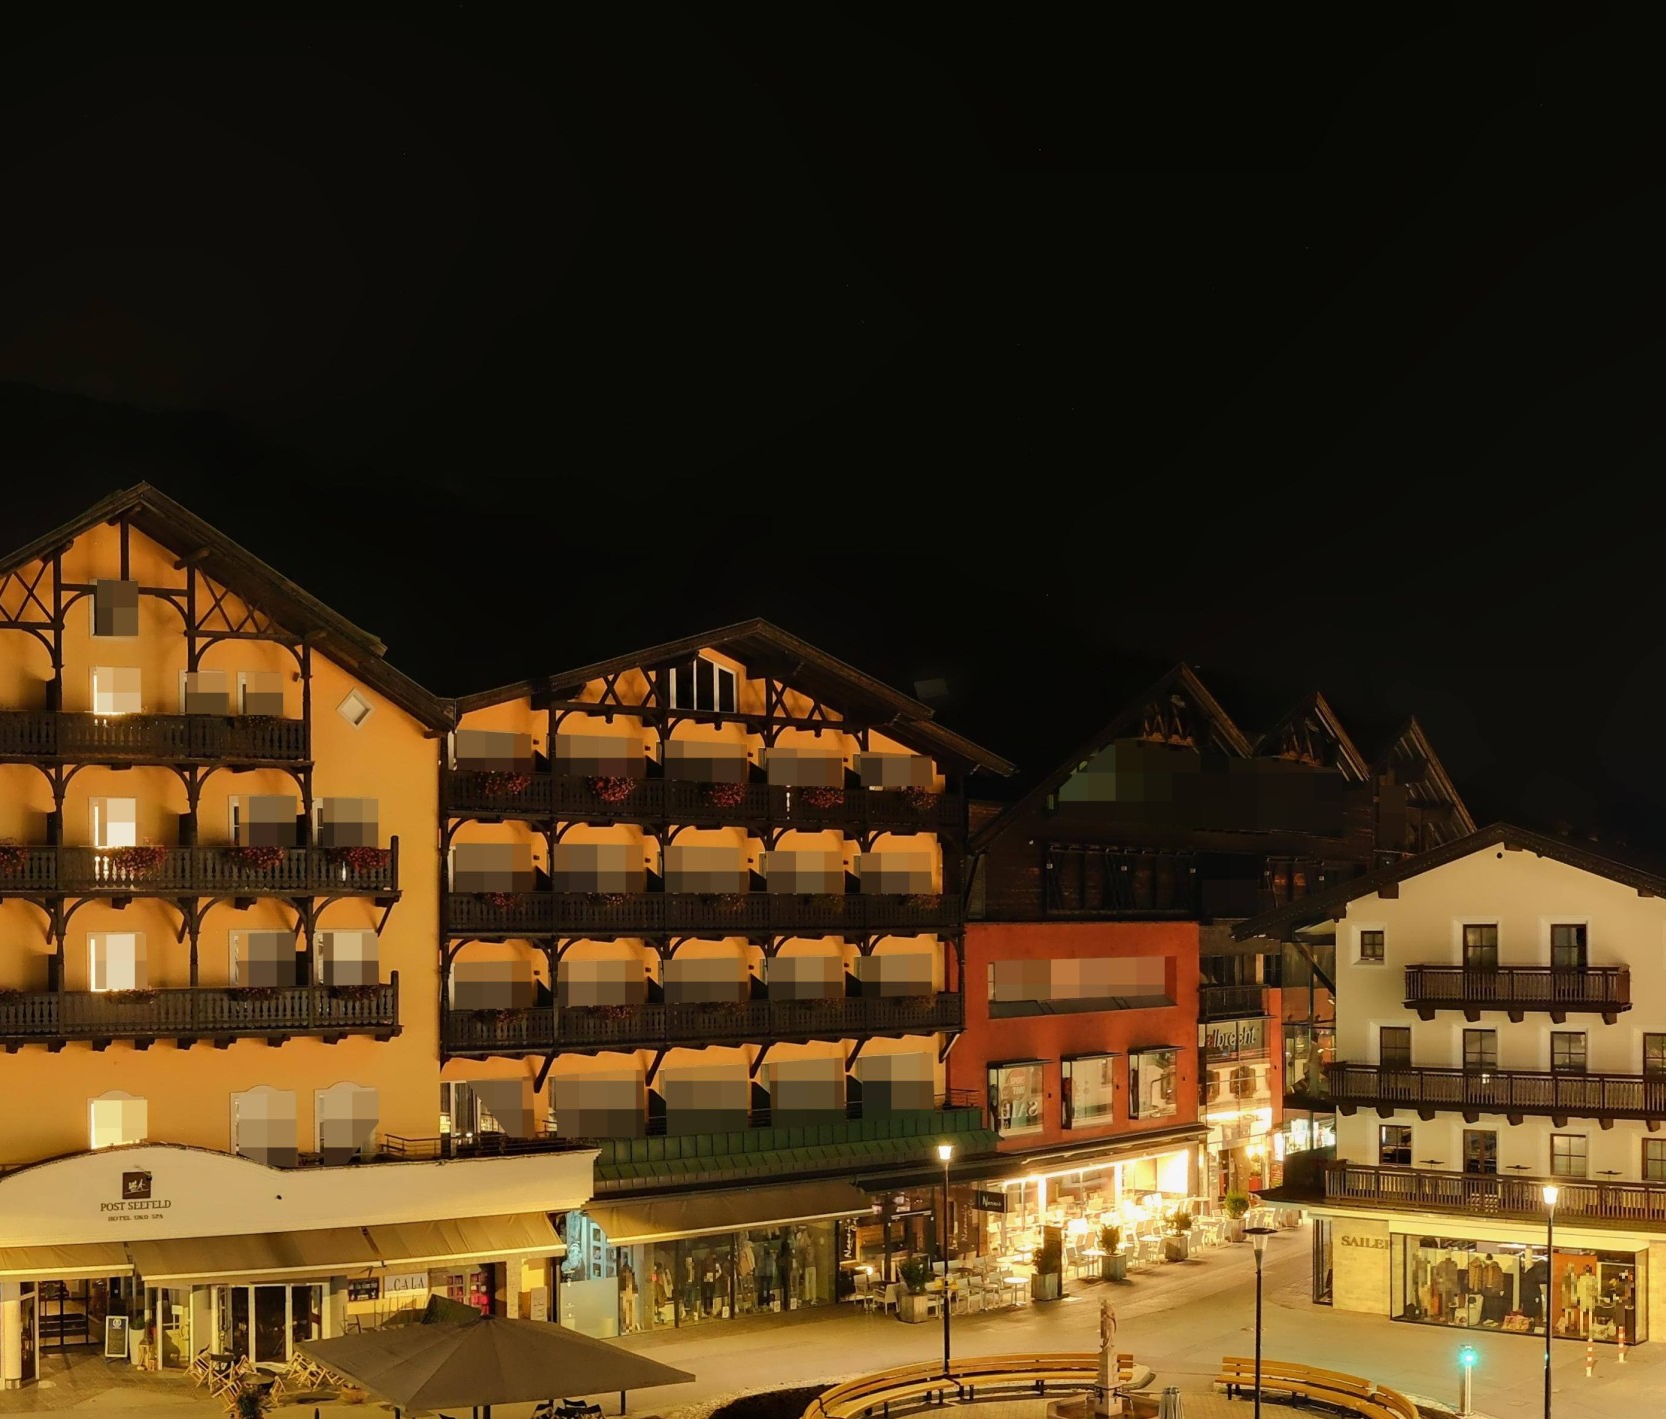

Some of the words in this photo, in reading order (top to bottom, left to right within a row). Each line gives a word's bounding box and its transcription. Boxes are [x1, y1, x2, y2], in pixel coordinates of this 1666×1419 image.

[1206, 1026, 1256, 1050] albrecht
[100, 1202, 126, 1212] POST
[128, 1200, 172, 1210] SEEFELD
